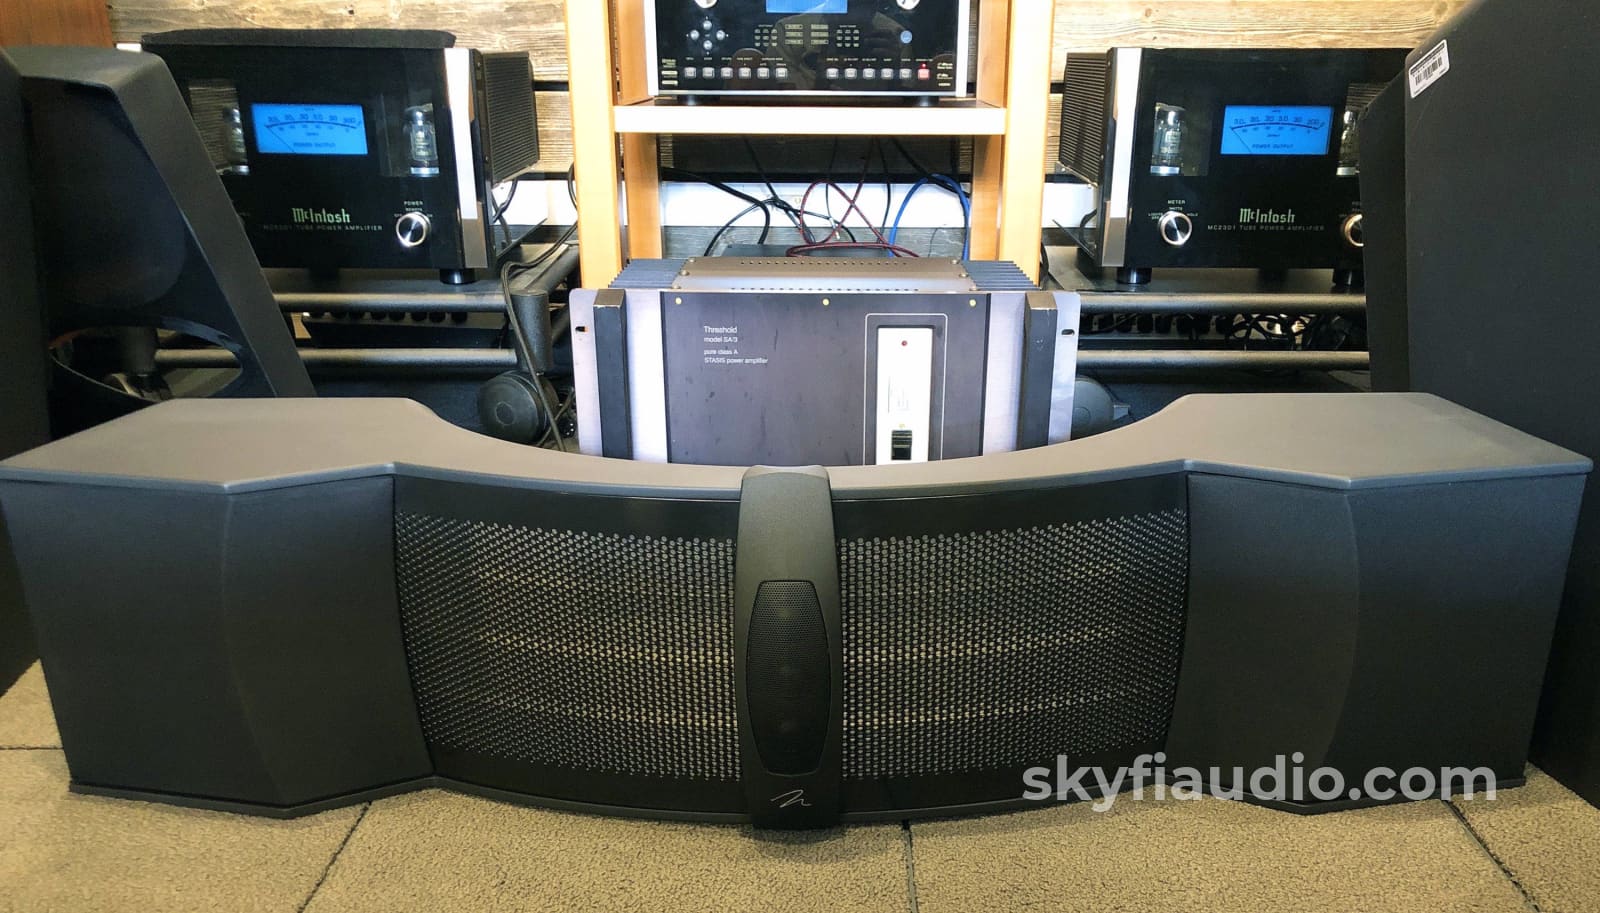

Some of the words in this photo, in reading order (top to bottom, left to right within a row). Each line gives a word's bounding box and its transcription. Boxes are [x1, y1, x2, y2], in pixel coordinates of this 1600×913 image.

[292, 207, 351, 223] McIntosh
[1239, 207, 1296, 223] McIntosh
[703, 325, 738, 334] Threshold
[744, 357, 769, 365] amplifier
